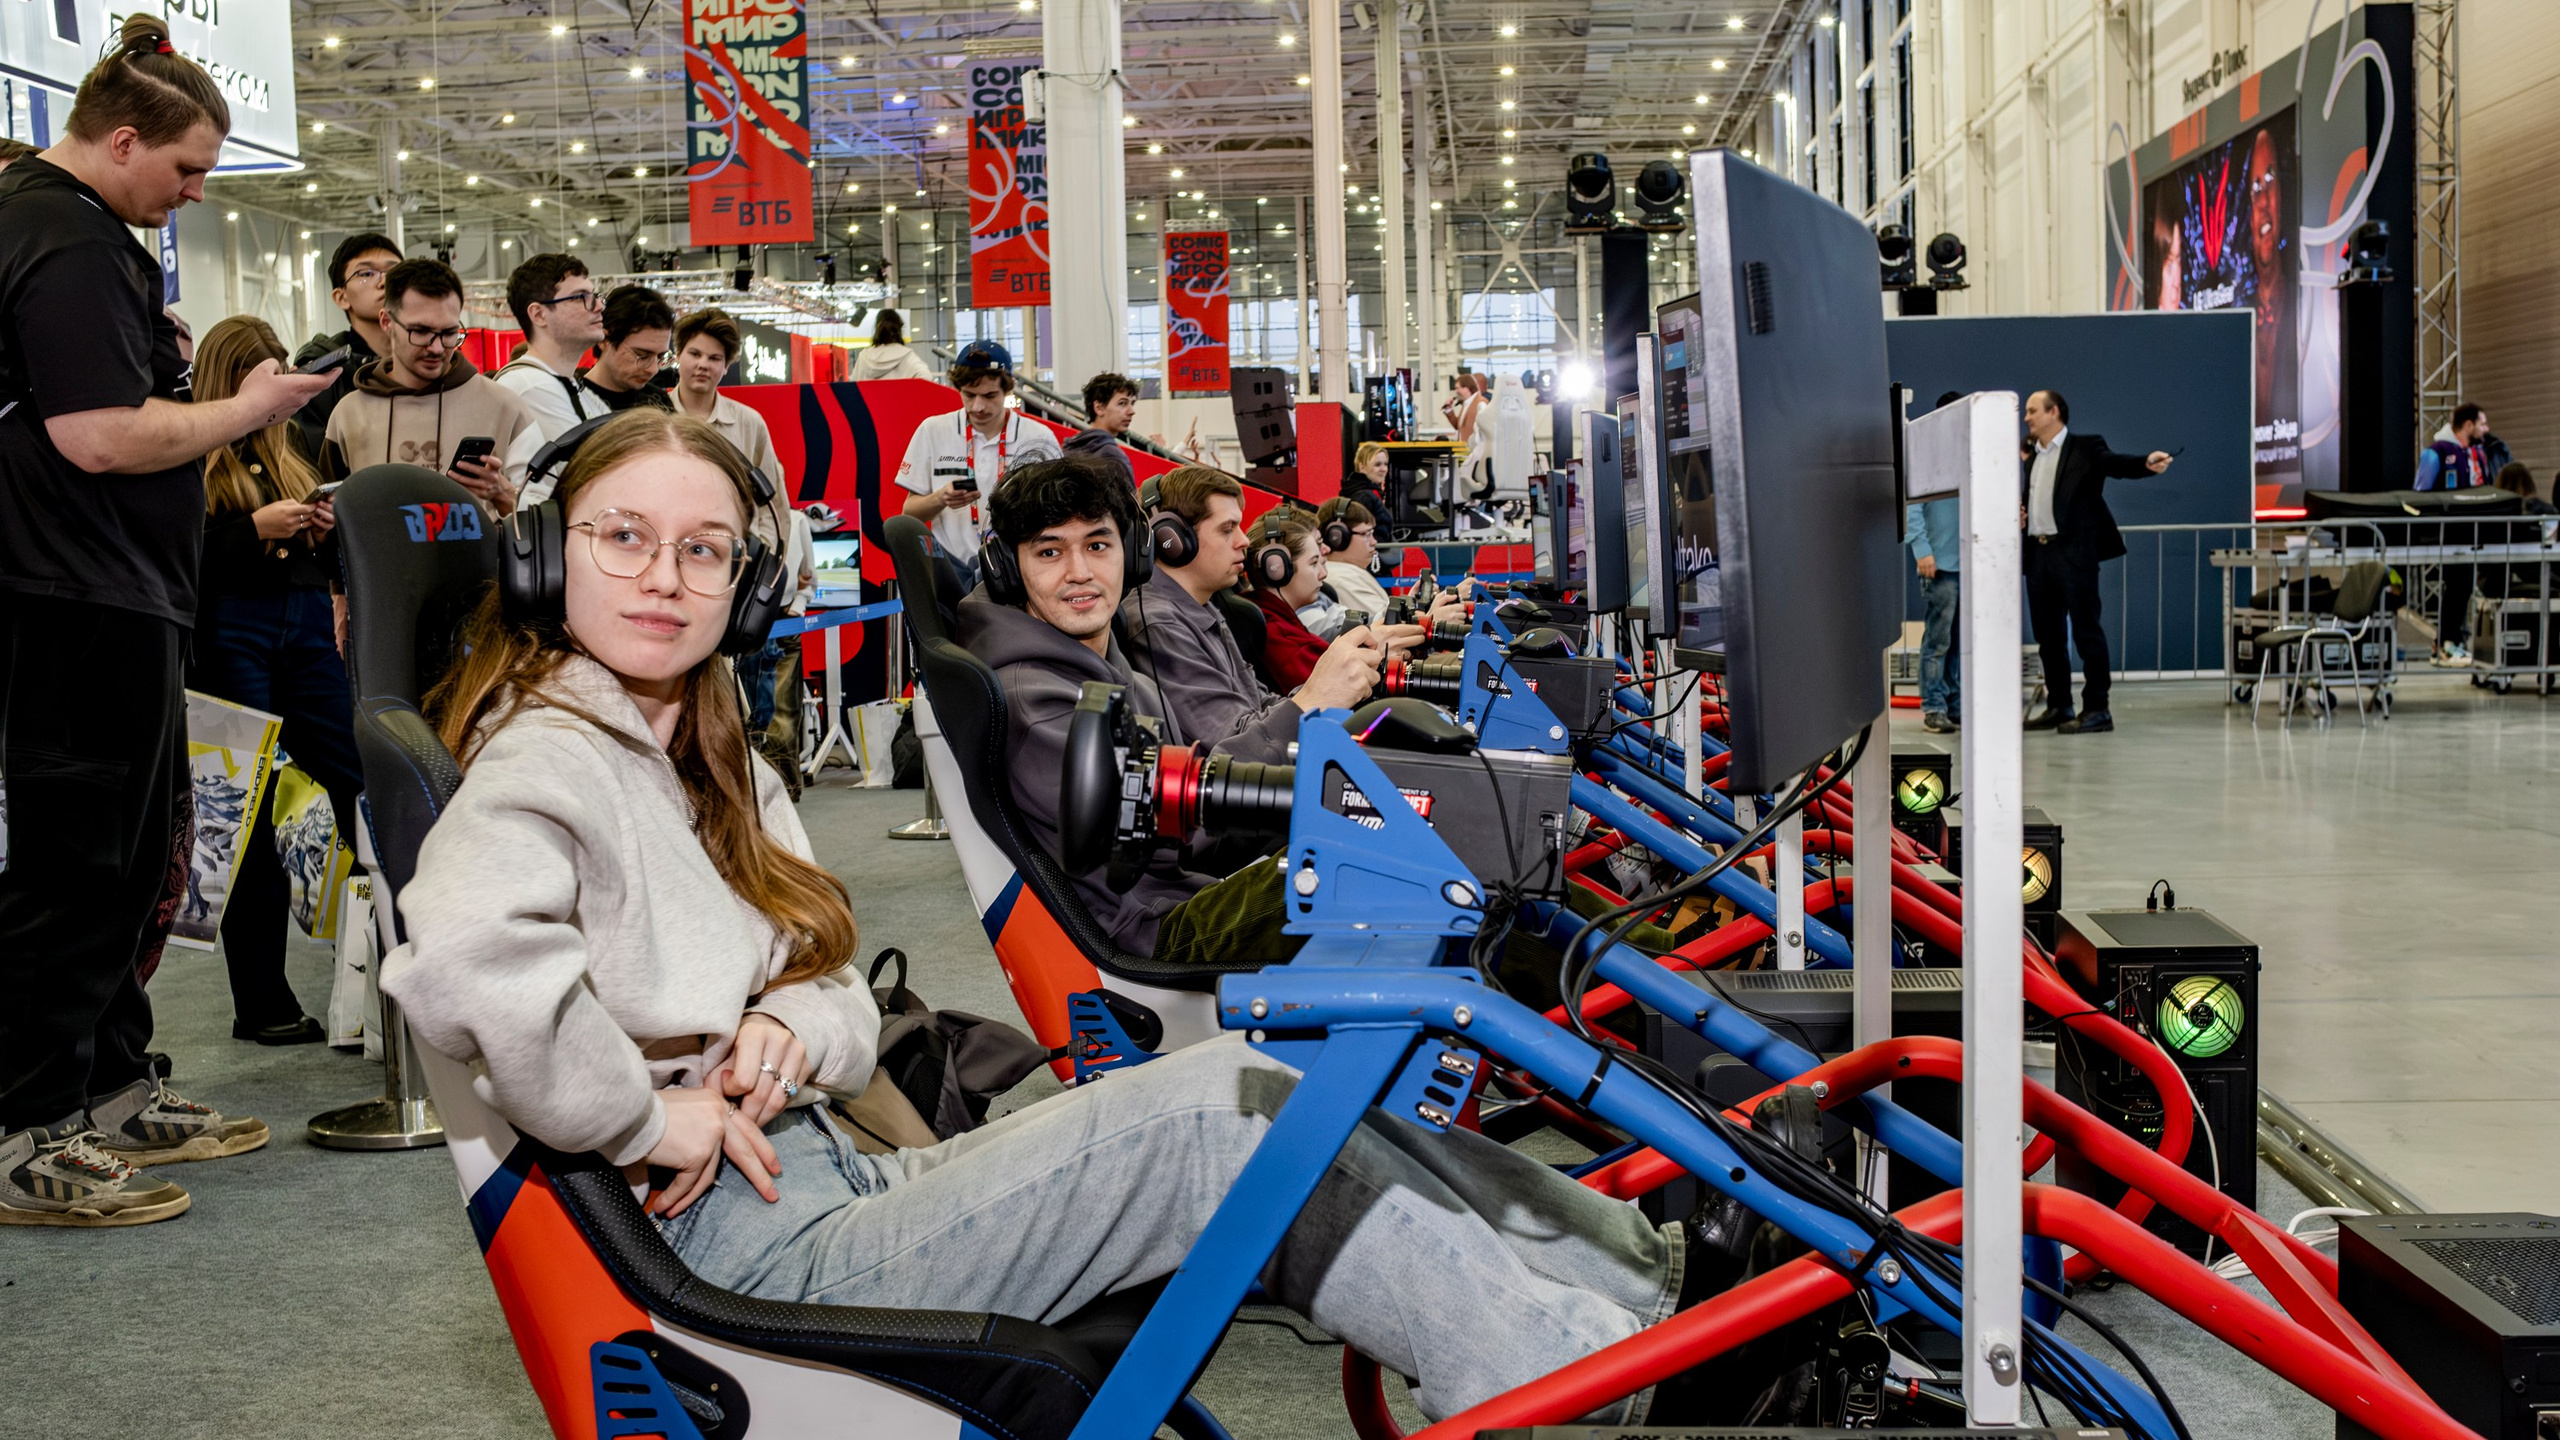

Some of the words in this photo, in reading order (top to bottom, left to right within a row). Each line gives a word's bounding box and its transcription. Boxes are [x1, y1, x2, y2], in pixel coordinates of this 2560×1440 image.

[693, 14, 798, 44] МИР
[973, 87, 1024, 107] CO
[738, 200, 792, 226] ВТБ
[1171, 236, 1224, 249] COMIC
[1171, 250, 1224, 263] CON
[1171, 264, 1224, 277] ИГРО
[1193, 369, 1221, 382] ВТБ
[245, 755, 267, 828] ENDFIELD
